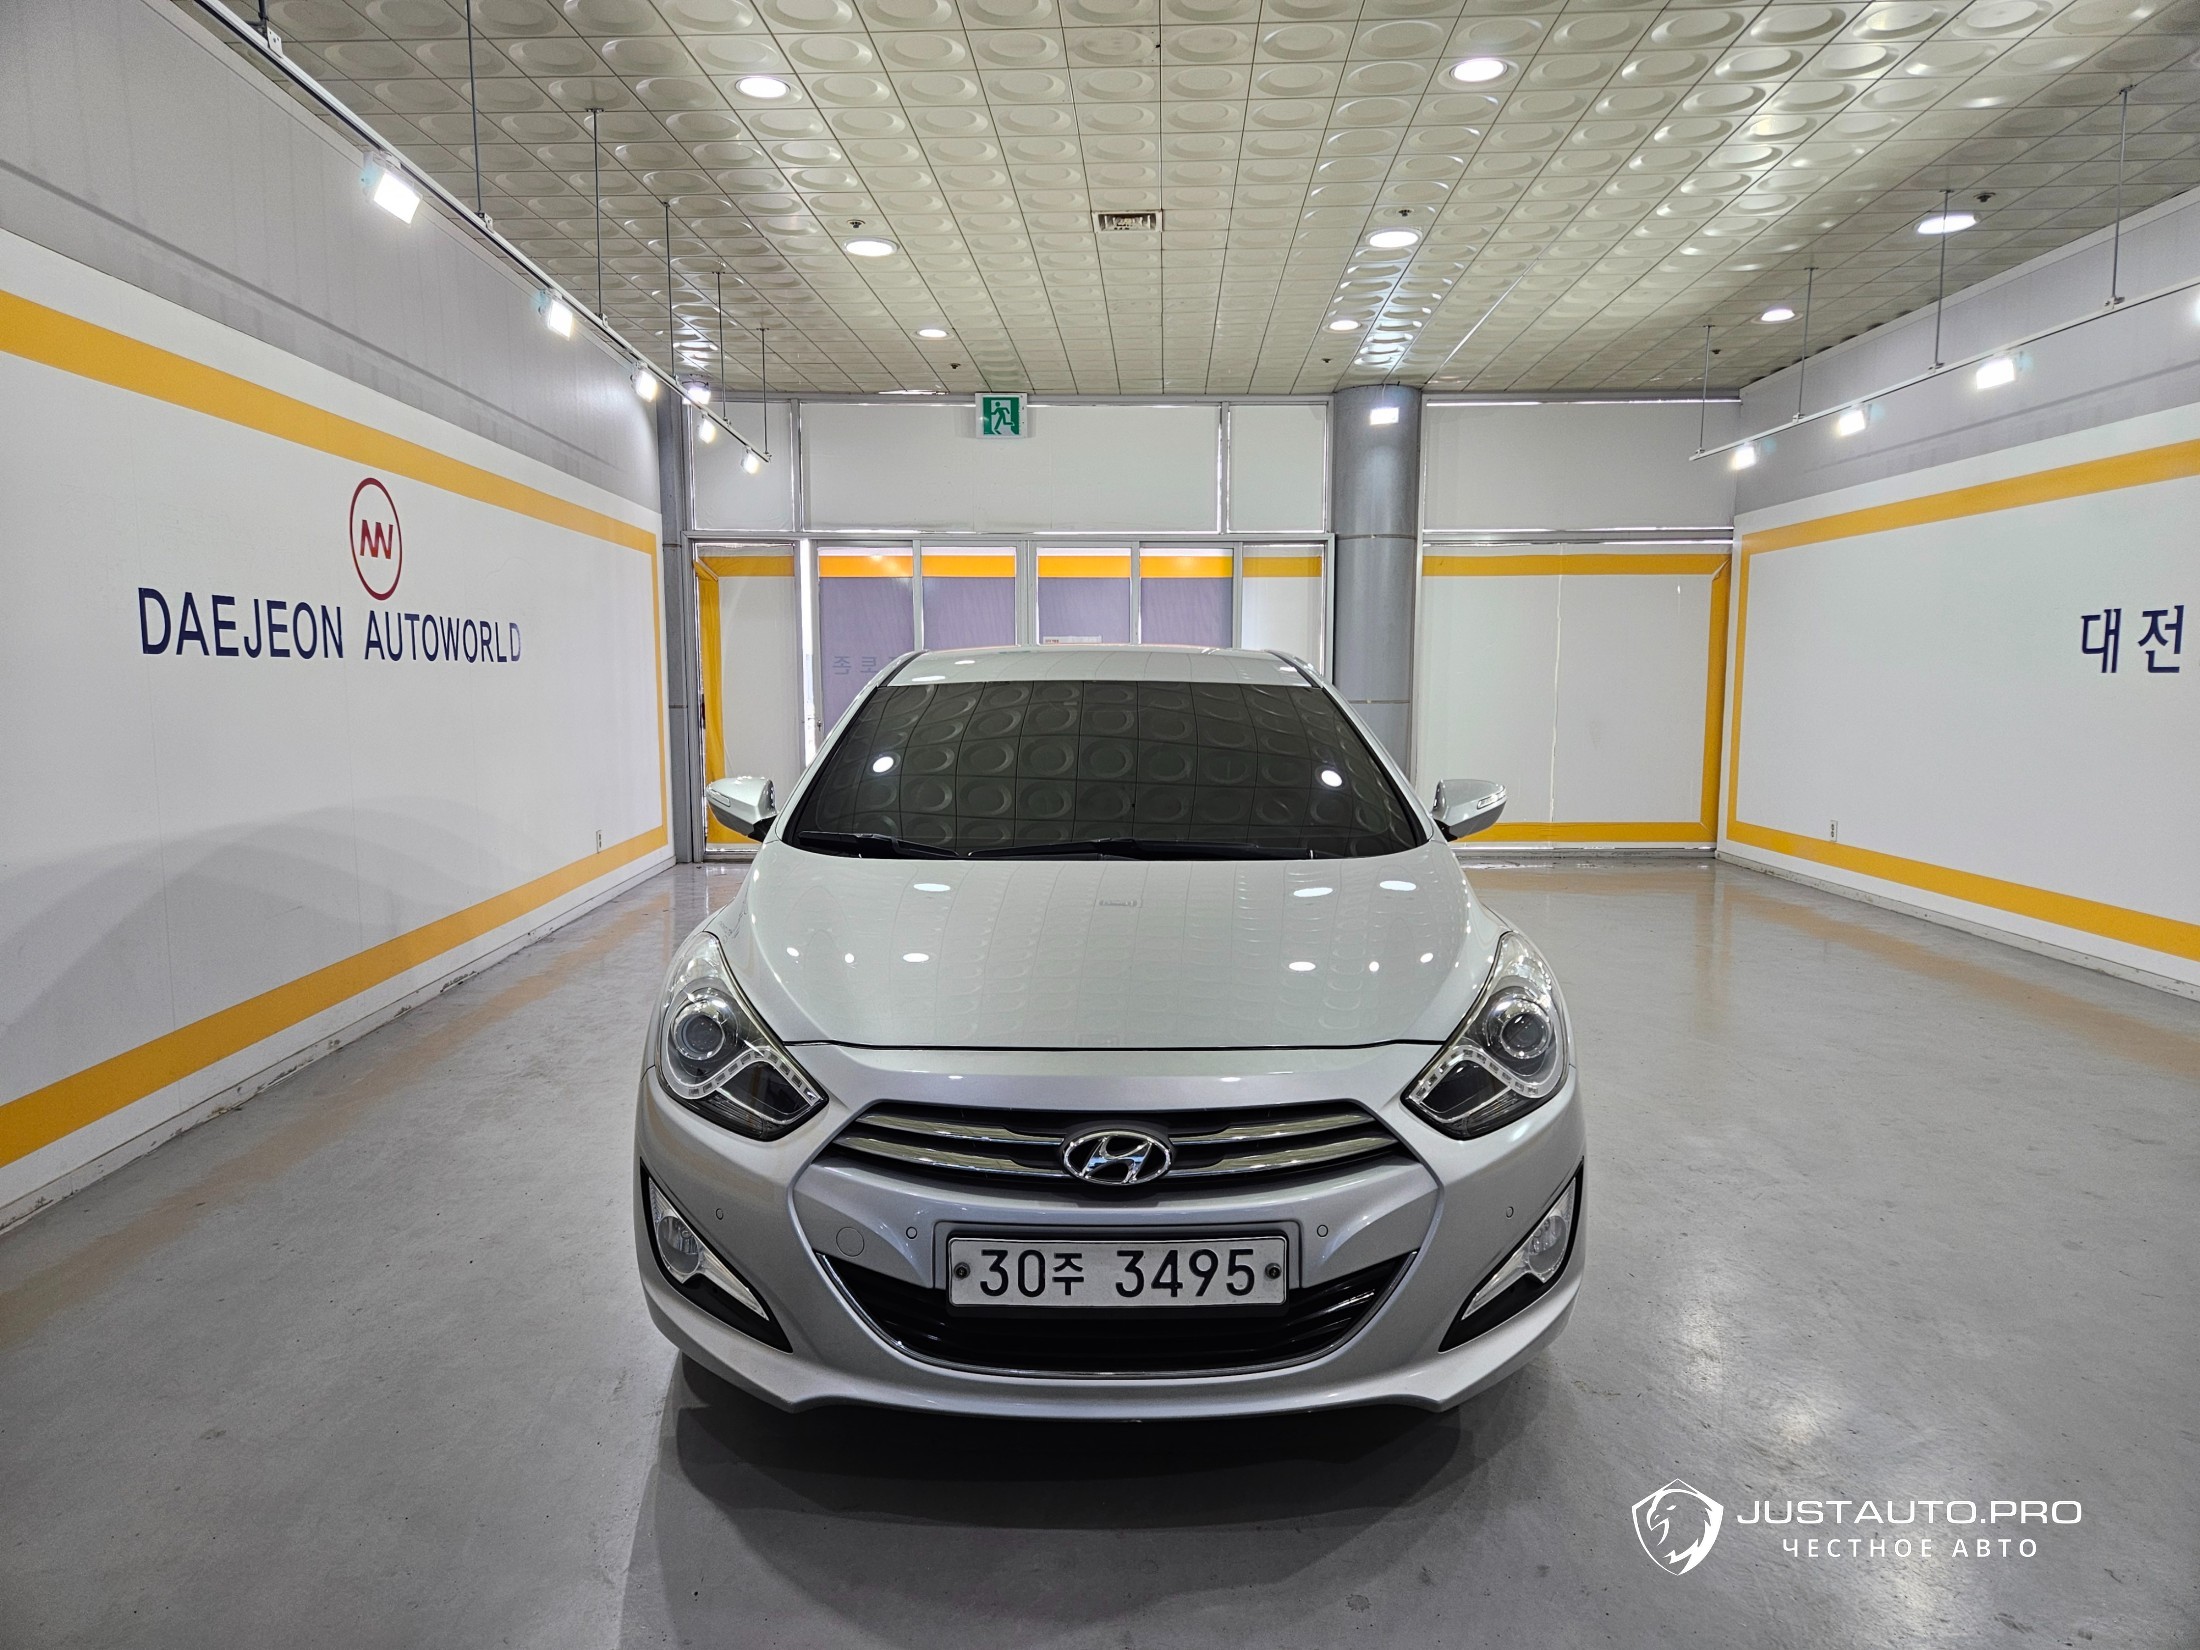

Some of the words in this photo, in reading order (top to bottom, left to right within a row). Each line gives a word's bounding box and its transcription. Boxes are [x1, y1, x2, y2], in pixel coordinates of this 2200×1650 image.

[138, 587, 344, 660] DAEJEON
[364, 609, 522, 664] AUTOWORLD
[2080, 604, 2185, 674] 대전
[979, 1248, 1085, 1298] 30주
[1115, 1248, 1255, 1298] 3495
